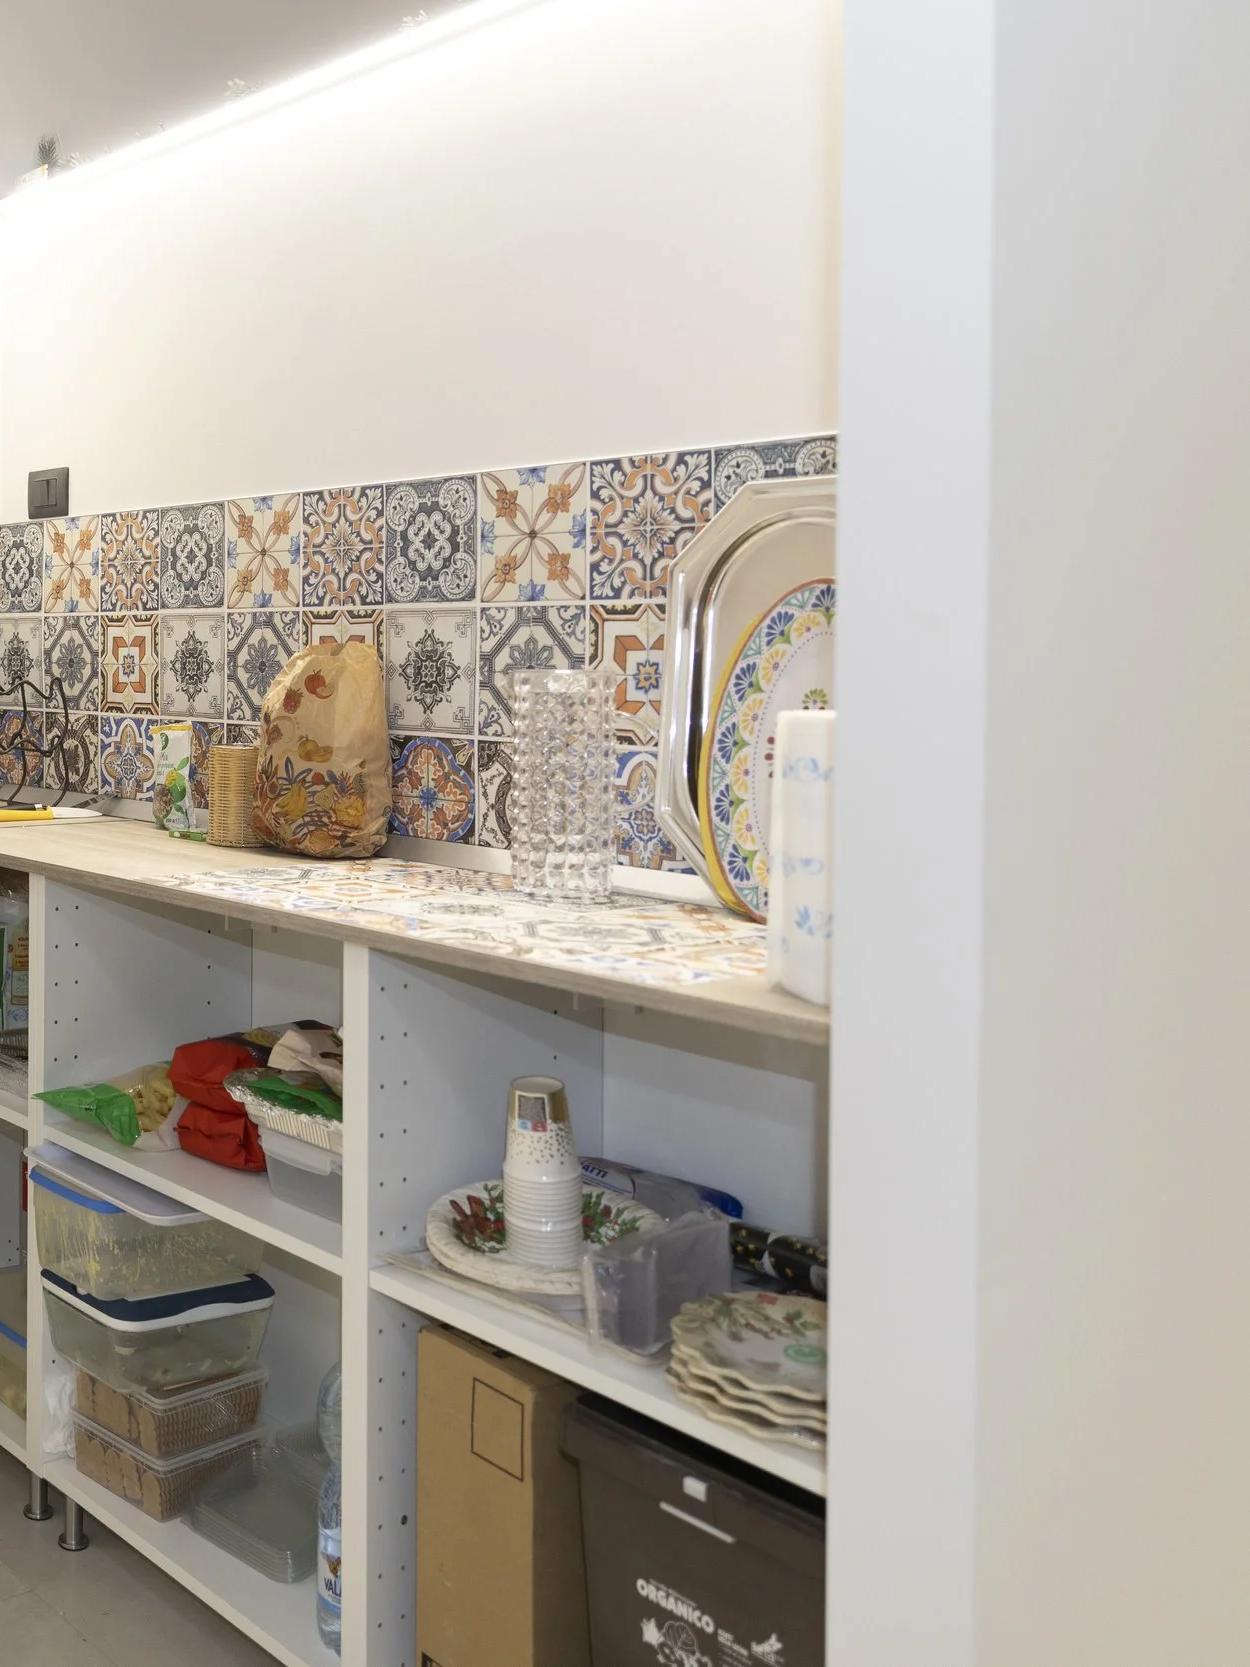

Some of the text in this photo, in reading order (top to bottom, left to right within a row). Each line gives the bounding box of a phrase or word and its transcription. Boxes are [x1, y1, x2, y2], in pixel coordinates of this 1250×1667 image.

[580, 1162, 608, 1179] ATTI
[324, 1577, 341, 1597] VAL
[636, 1578, 715, 1634] ORGANICO
